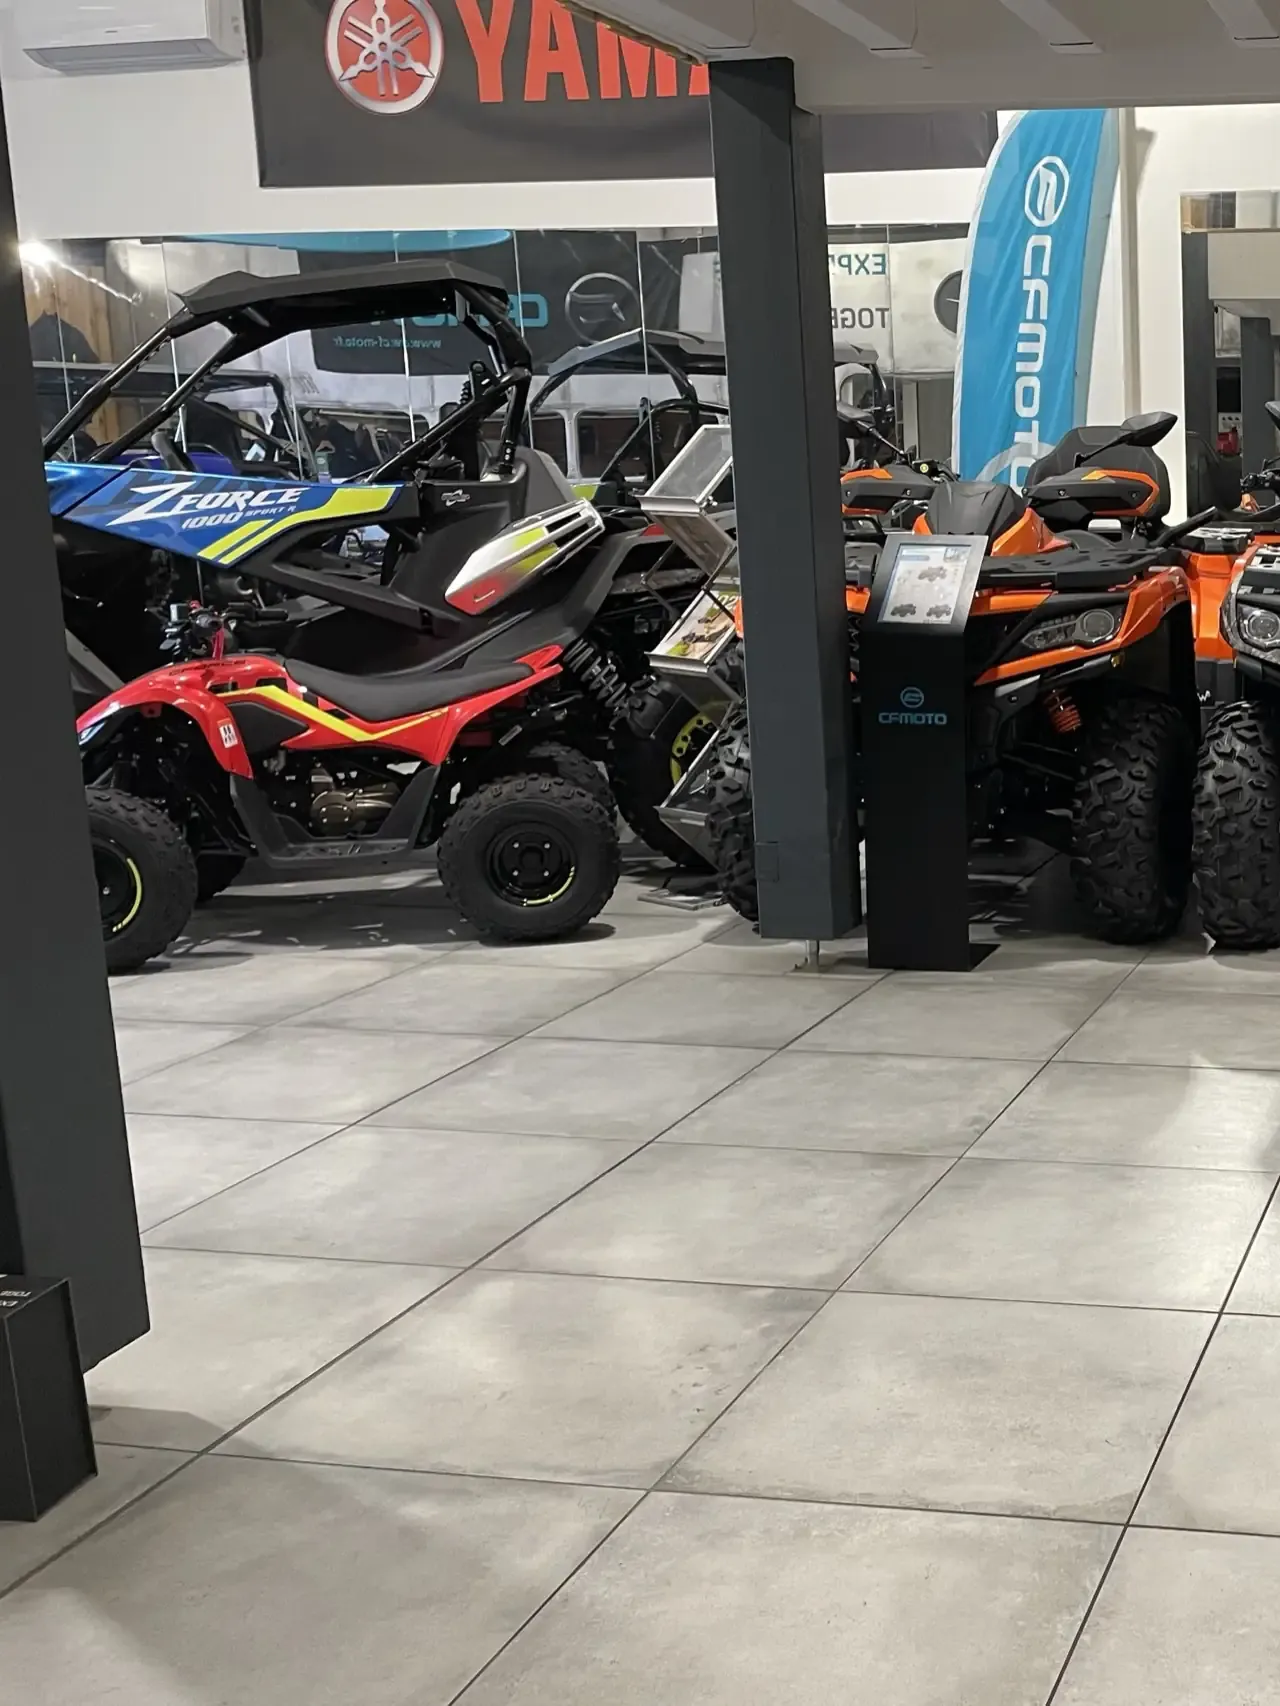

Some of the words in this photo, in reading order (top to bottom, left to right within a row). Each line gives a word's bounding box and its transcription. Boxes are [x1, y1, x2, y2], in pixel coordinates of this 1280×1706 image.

[455, 0, 710, 103] YAM
[182, 511, 244, 529] 1000
[878, 712, 948, 725] CFMOTO
